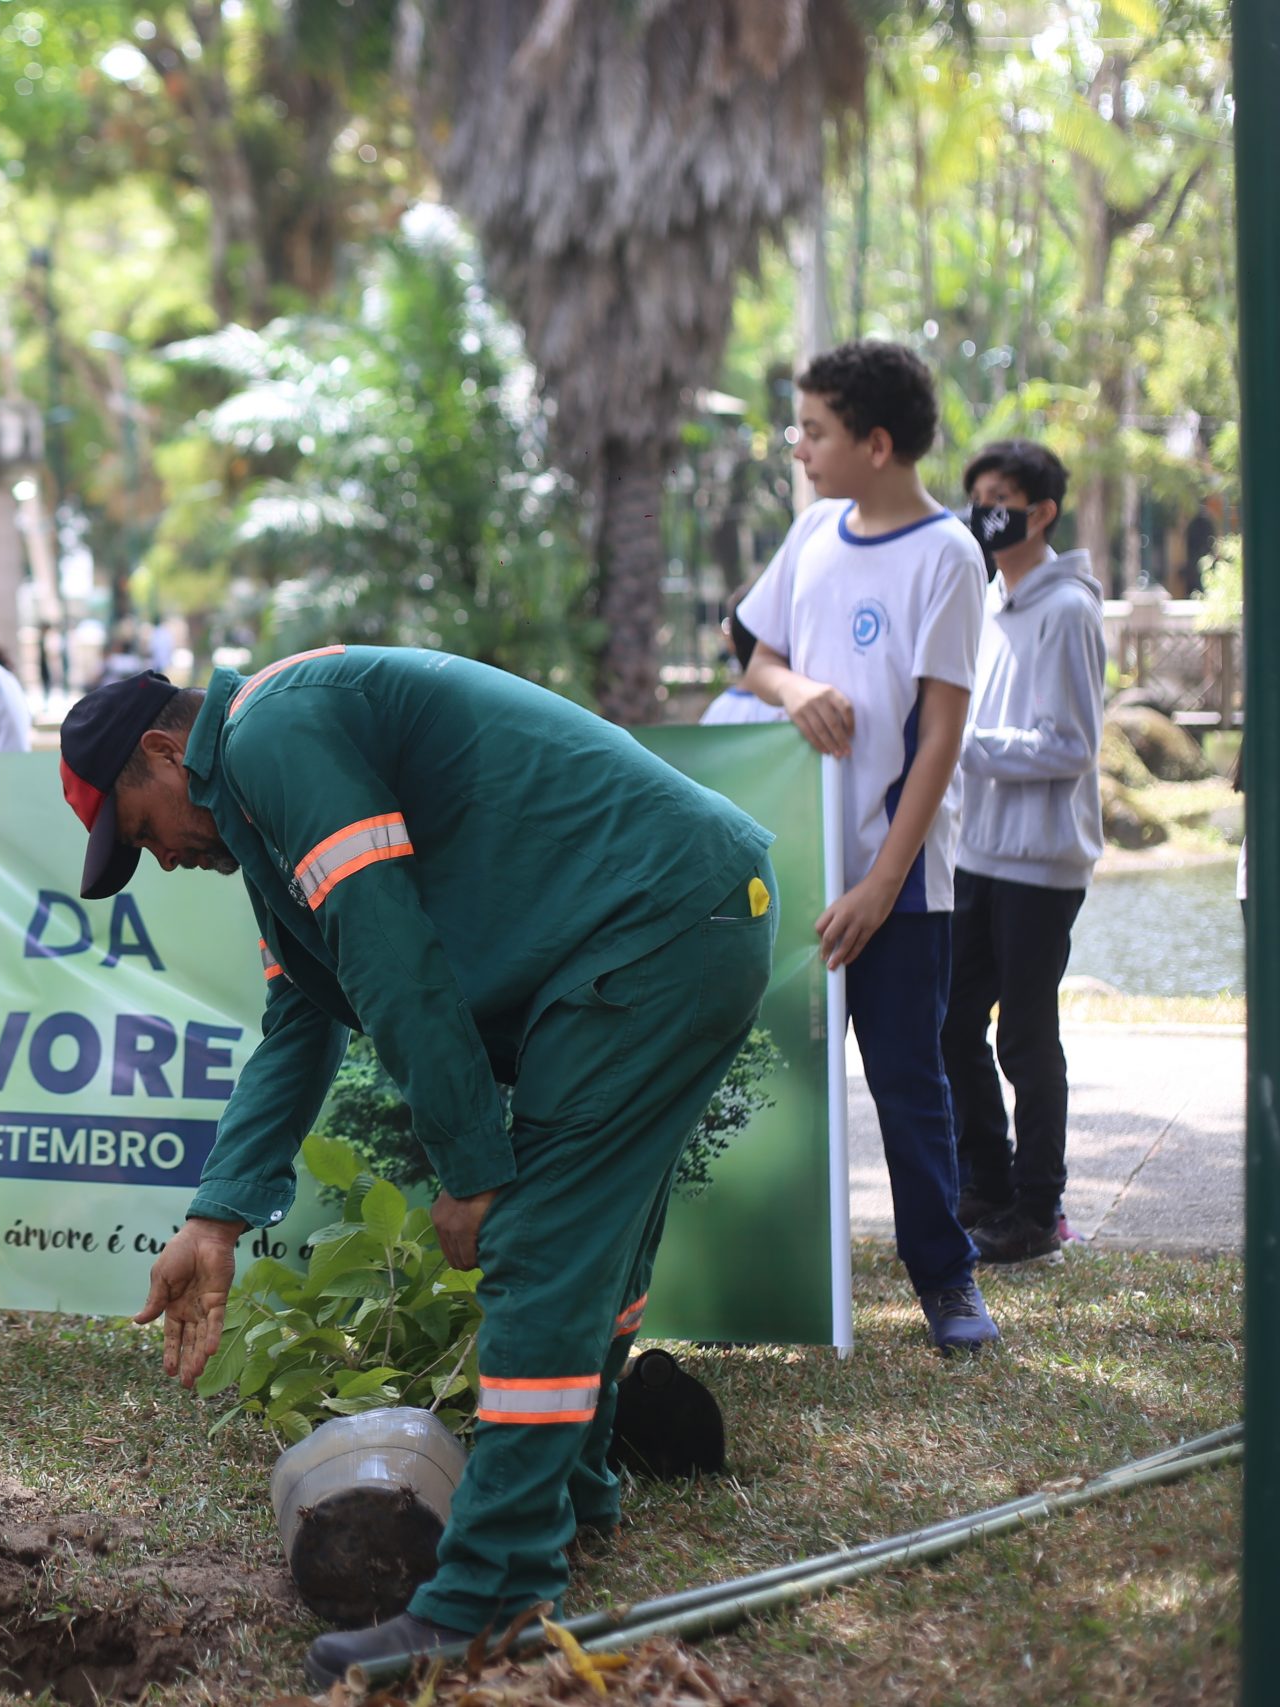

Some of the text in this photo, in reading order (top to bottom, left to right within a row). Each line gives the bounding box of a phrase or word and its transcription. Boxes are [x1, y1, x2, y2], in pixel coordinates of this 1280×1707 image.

[24, 889, 166, 972] DA
[4, 1219, 99, 1252] árvore
[107, 1224, 126, 1254] é
[252, 1228, 287, 1259] do
